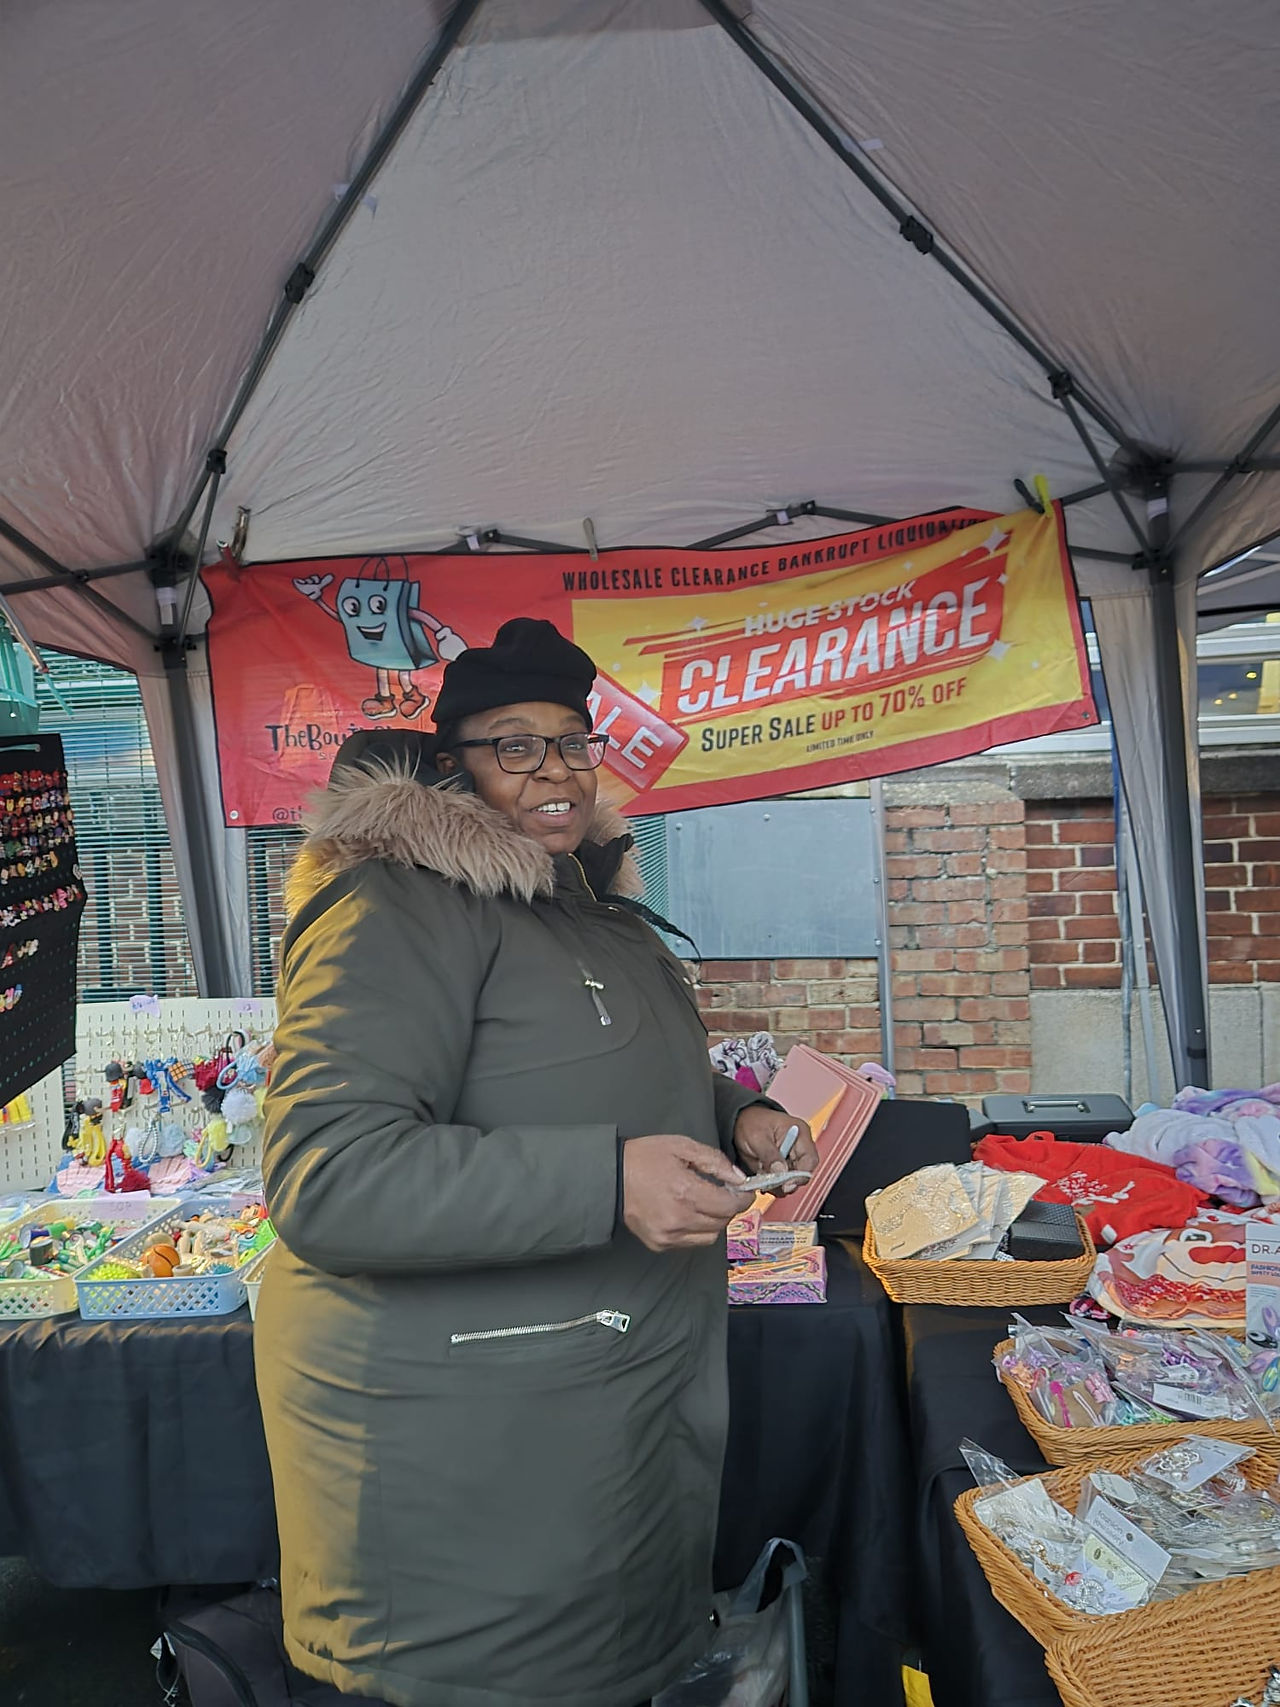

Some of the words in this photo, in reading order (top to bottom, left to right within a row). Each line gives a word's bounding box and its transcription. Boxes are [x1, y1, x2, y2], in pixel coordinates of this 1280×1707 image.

[562, 567, 663, 592] WHOLESALE
[670, 560, 770, 588] CLEARANCE
[778, 538, 870, 572] BANKRUPT
[743, 605, 823, 638] HUGE
[826, 579, 917, 624] STOCK
[676, 576, 992, 714] CLEARANCE
[701, 724, 763, 753] SUPER
[769, 714, 817, 741] SALE
[821, 710, 846, 732] UP
[851, 702, 874, 723] TO
[879, 684, 926, 717] 70%
[932, 677, 967, 705] OFF
